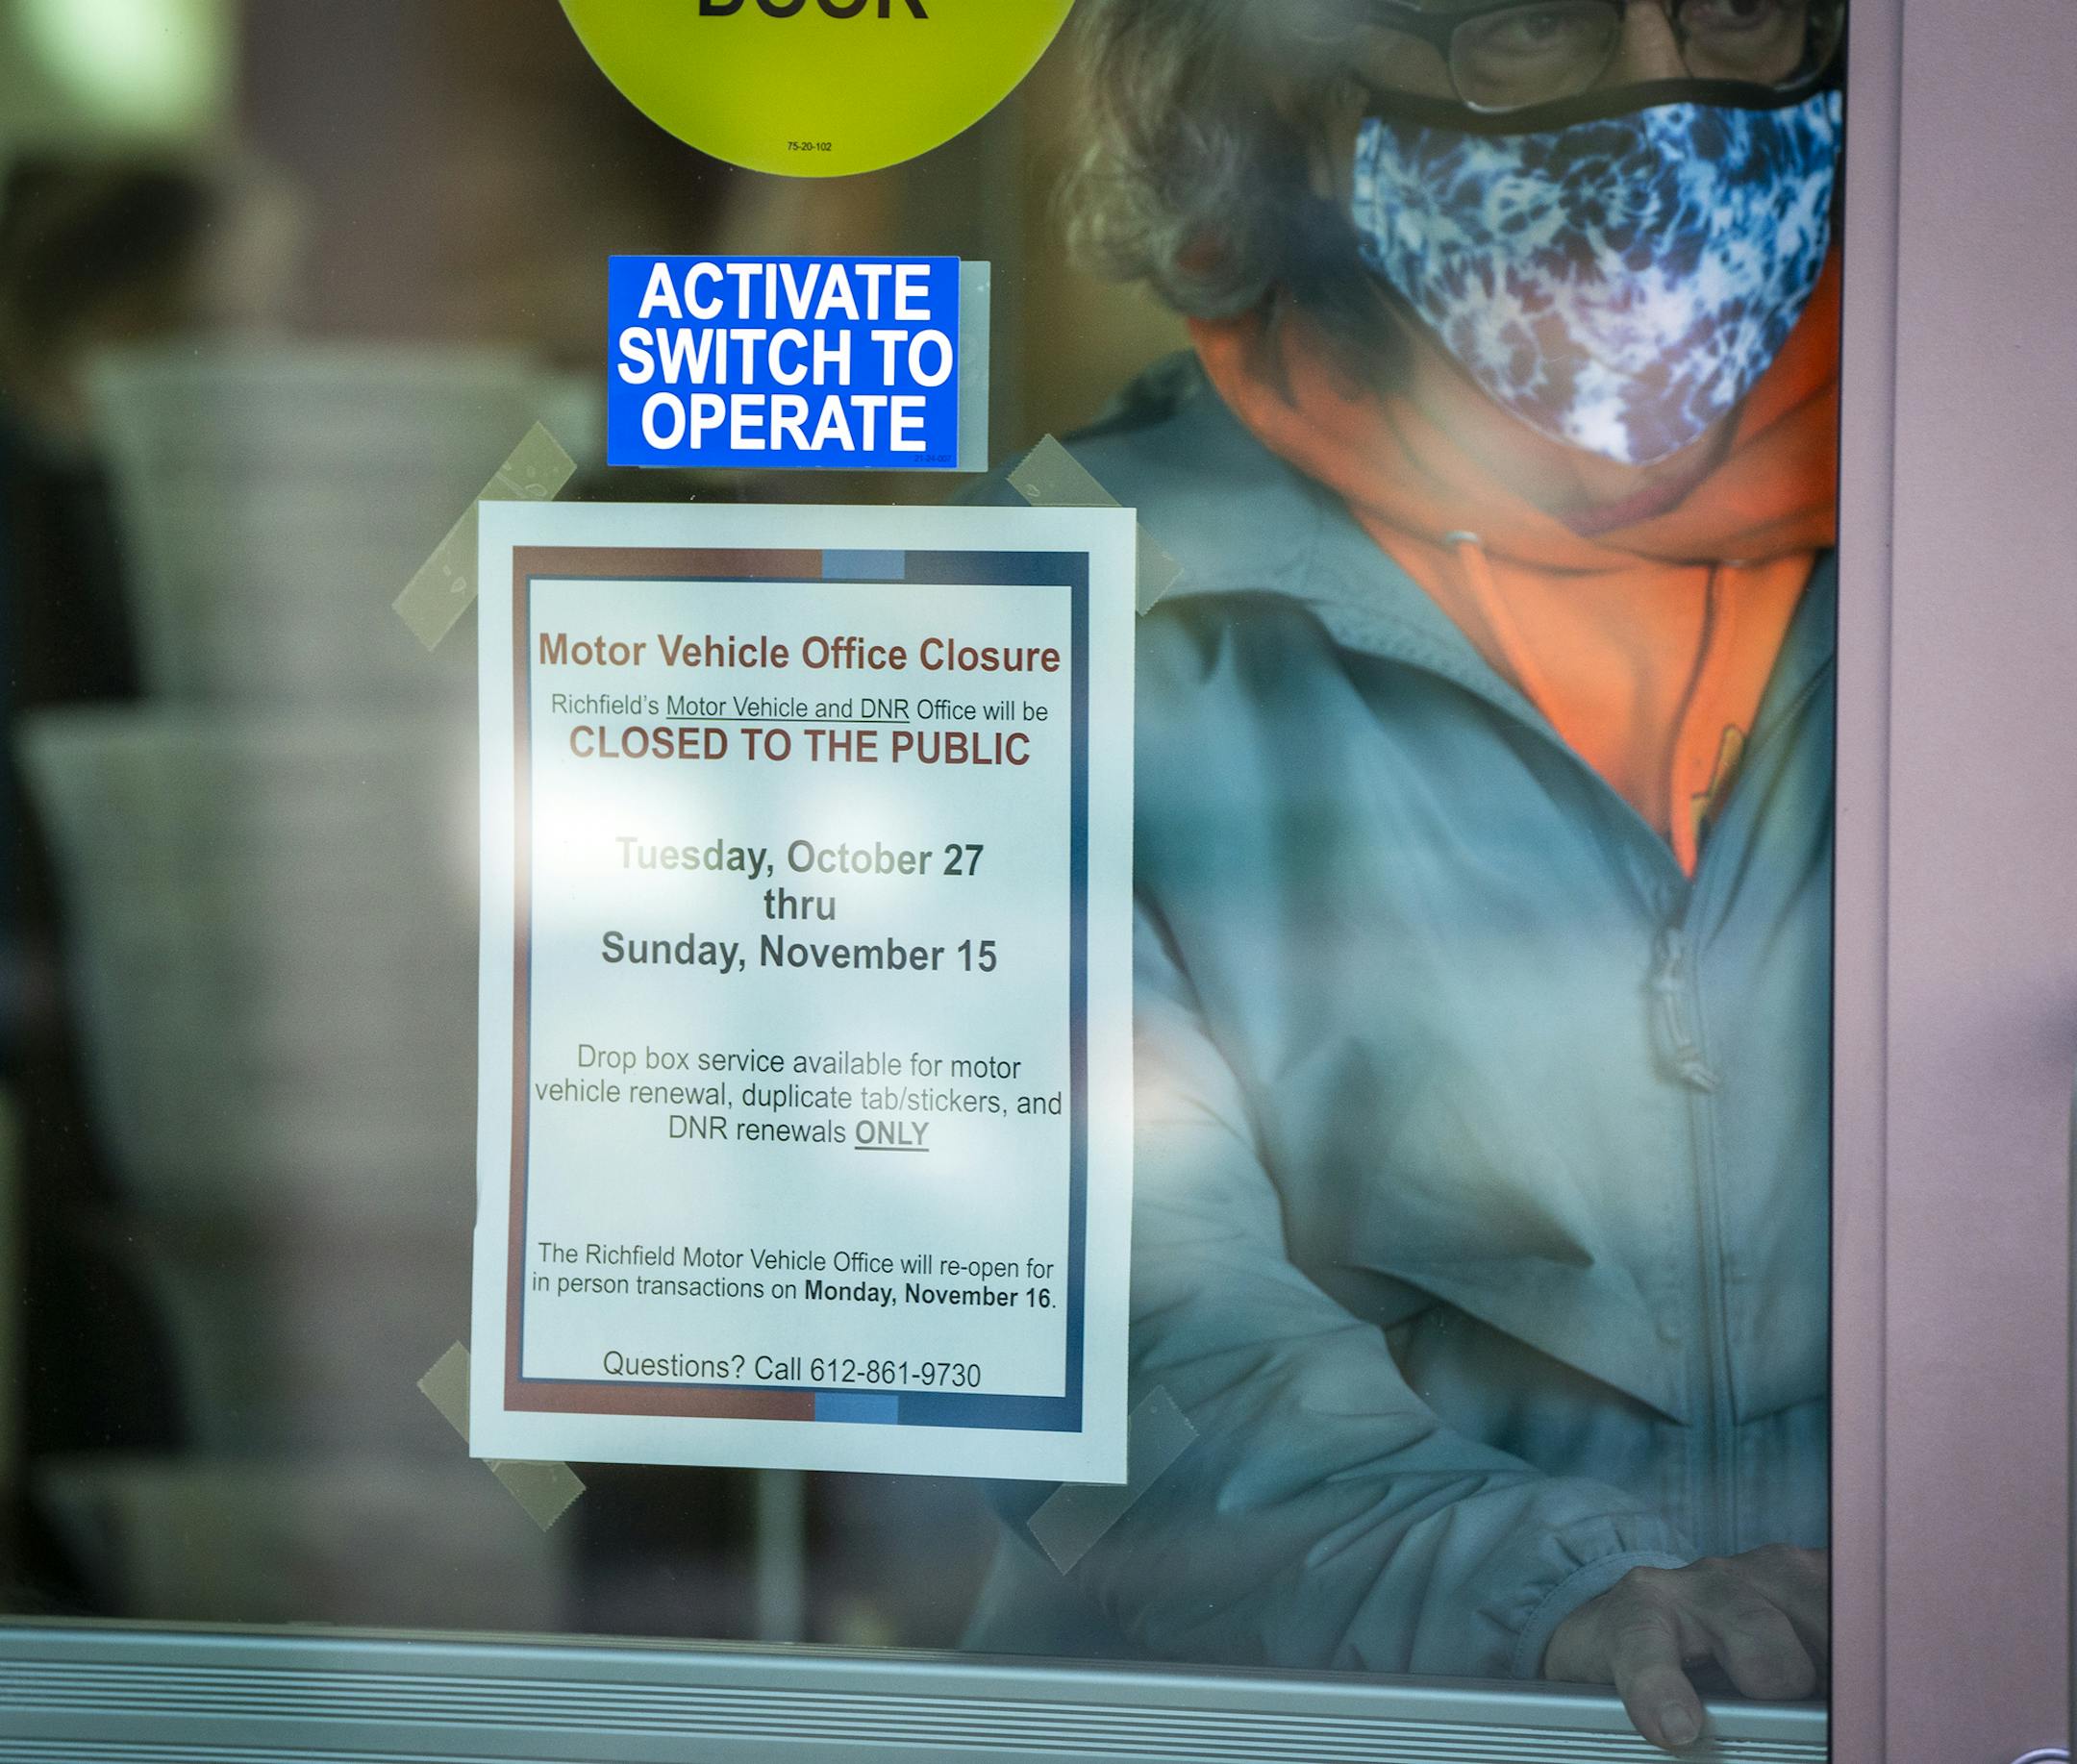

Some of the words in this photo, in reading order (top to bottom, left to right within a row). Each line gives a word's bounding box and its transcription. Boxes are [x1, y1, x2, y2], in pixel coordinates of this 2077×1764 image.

[788, 141, 832, 151] 75-20-102
[638, 262, 930, 320] ACTIVATE
[618, 327, 850, 385] SWITCH
[871, 330, 953, 386] TO
[642, 392, 926, 451] OPERATE
[540, 633, 646, 665] Motor
[658, 634, 788, 668] Vehicle
[803, 636, 907, 670] Office
[920, 637, 1060, 672] Closure
[553, 694, 659, 715] Richfield’s
[667, 695, 726, 715] Motor
[734, 696, 808, 717] Vehicle
[815, 698, 852, 718] and
[862, 699, 909, 719] DNR
[917, 699, 976, 720] Office
[983, 701, 1014, 720] will
[1024, 701, 1047, 721] be
[571, 726, 727, 759] CLOSED
[741, 729, 791, 761] TO
[804, 730, 877, 762] THE
[892, 731, 1030, 765] PUBLIC
[616, 837, 773, 879] Tuesday,
[788, 840, 933, 875] October
[943, 844, 984, 876] 27
[763, 887, 835, 920] thru
[602, 932, 745, 974] Sunday,
[761, 934, 944, 970] November
[958, 939, 996, 972] 15
[579, 1044, 636, 1075] Drop
[646, 1046, 688, 1070] box
[699, 1049, 785, 1073] service
[793, 1051, 901, 1076] available
[911, 1053, 942, 1077] for
[952, 1056, 1021, 1079] motor
[536, 1079, 620, 1103] vehicle
[631, 1082, 732, 1109] renewal,
[742, 1082, 851, 1112] duplicate
[861, 1086, 1007, 1117] tab/stickers,
[1017, 1092, 1061, 1114] and
[670, 1115, 728, 1139] DNR
[738, 1120, 845, 1143] renewals
[856, 1120, 929, 1145] ONLY
[538, 1243, 578, 1263] The
[587, 1244, 674, 1266] Richfield
[684, 1247, 743, 1268] Motor
[751, 1249, 826, 1271] Vehicle
[834, 1252, 893, 1273] Office
[901, 1255, 932, 1274] will
[940, 1260, 1018, 1281] re-open
[1026, 1258, 1054, 1279] for
[533, 1272, 549, 1291] in
[558, 1278, 628, 1297] person
[637, 1276, 763, 1298] transactions
[772, 1284, 796, 1299] on
[806, 1280, 896, 1307] Monday,
[906, 1283, 1018, 1306] November
[1027, 1288, 1055, 1307] 16.
[603, 1351, 745, 1379] Questions?
[755, 1355, 800, 1380] Call
[811, 1358, 981, 1387] 612-861-9730
